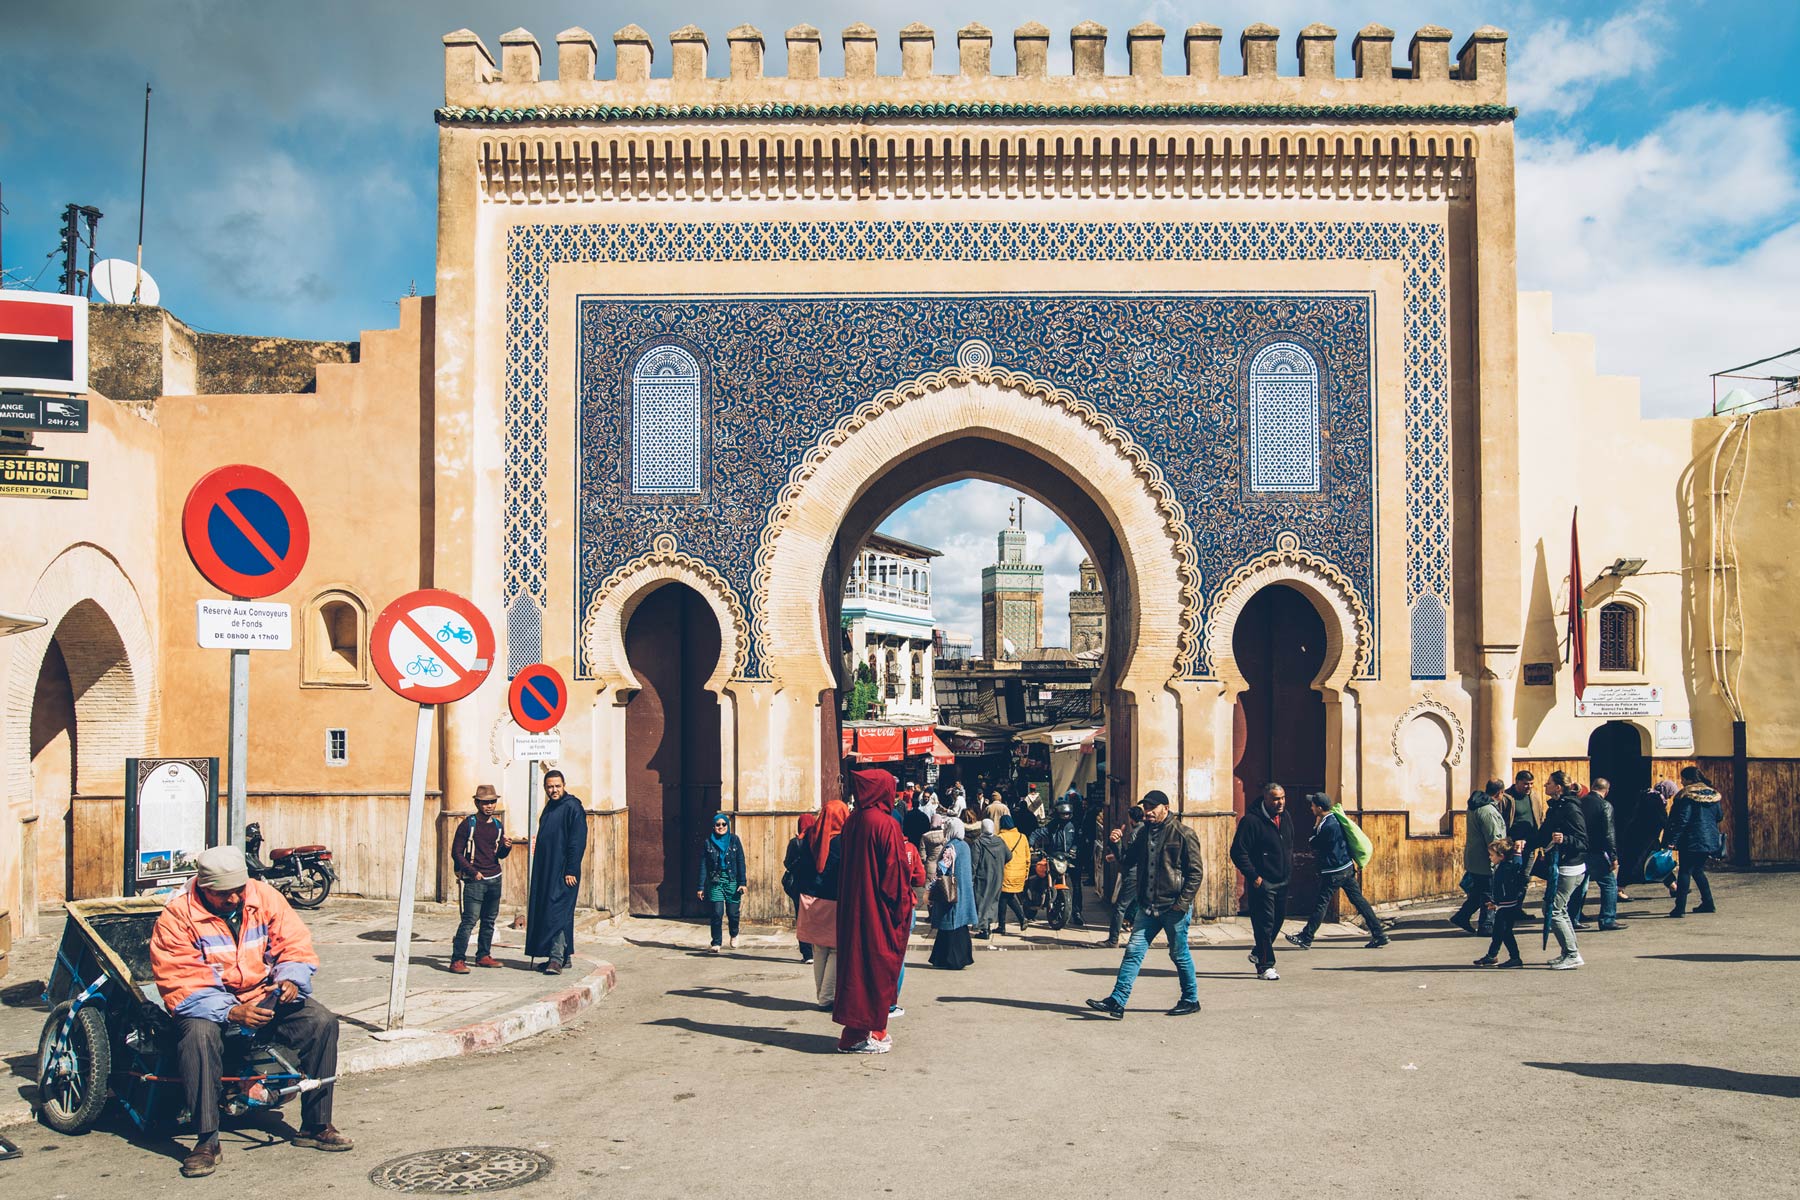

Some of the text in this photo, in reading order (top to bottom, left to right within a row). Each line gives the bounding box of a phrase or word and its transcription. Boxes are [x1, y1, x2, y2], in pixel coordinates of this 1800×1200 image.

[4, 471, 59, 482] UNION
[32, 487, 74, 496] D'ARGENT
[234, 607, 247, 615] Aux
[249, 608, 288, 618] Convoyeurs
[231, 619, 263, 628] de Fonds
